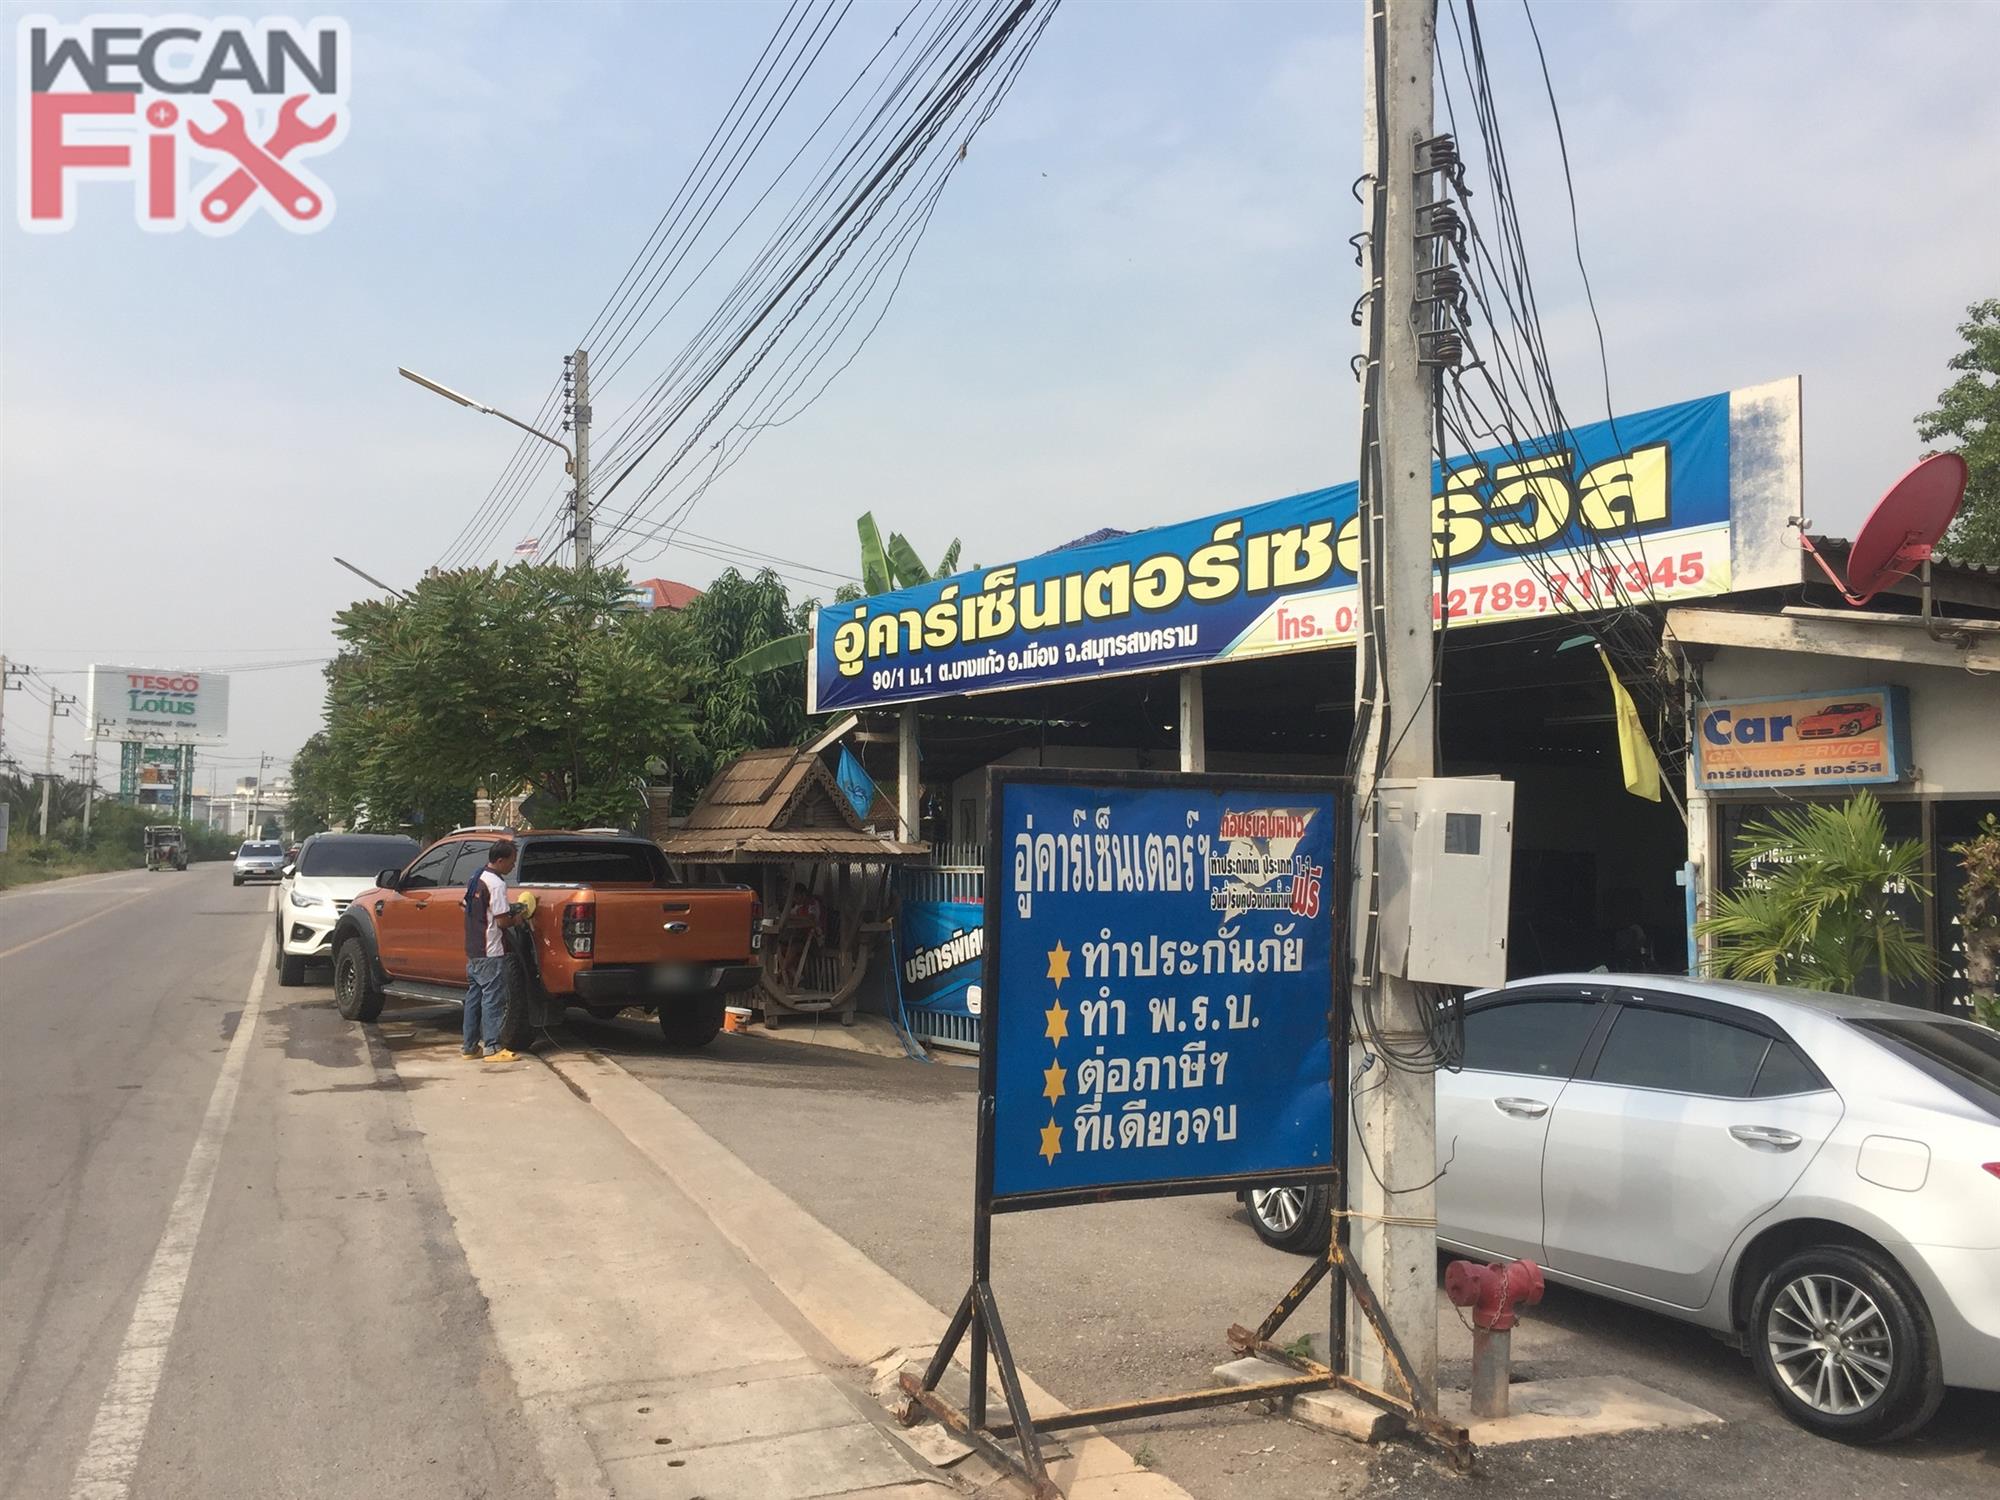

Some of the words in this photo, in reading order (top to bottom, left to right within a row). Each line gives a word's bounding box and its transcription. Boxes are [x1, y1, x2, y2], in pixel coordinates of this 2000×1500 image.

[873, 664, 904, 691] 90/1
[911, 664, 932, 686] ม.1
[939, 649, 1005, 682] ต.บางแก้ว
[1008, 642, 1059, 672] อ.เมือง
[1065, 624, 1198, 666] จ.สมุทรสงคราม
[127, 674, 198, 692] TESCO
[129, 694, 196, 715] Lotus
[1704, 710, 1792, 745] Car
[1791, 742, 1877, 758] SERVICE
[1081, 923, 1304, 977] ทำประกันภัย
[1079, 986, 1126, 1036] ทำ
[1149, 994, 1260, 1033] พ.ร.บ.
[1077, 1040, 1228, 1095] ต่อภาษีฯ
[1074, 1094, 1237, 1151] ที่เดียวจบ
